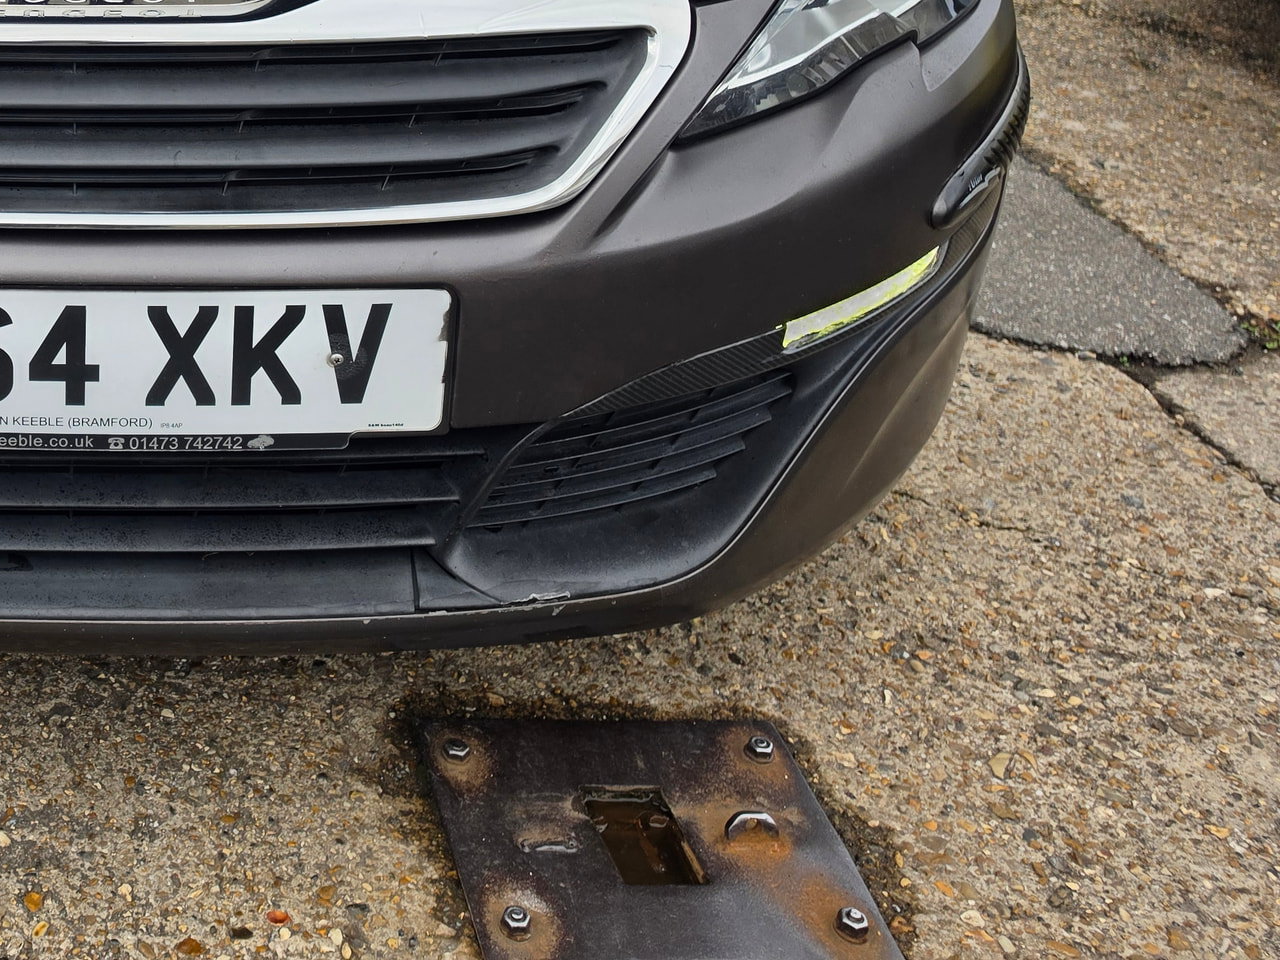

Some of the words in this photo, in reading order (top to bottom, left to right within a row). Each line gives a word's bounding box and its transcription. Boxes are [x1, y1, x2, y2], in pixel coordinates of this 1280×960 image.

[145, 303, 393, 407] XKV
[12, 416, 64, 427] KEEBLE
[67, 417, 153, 429] (BRAMFORD)
[129, 436, 179, 450] 01473
[184, 436, 243, 450] 742742
